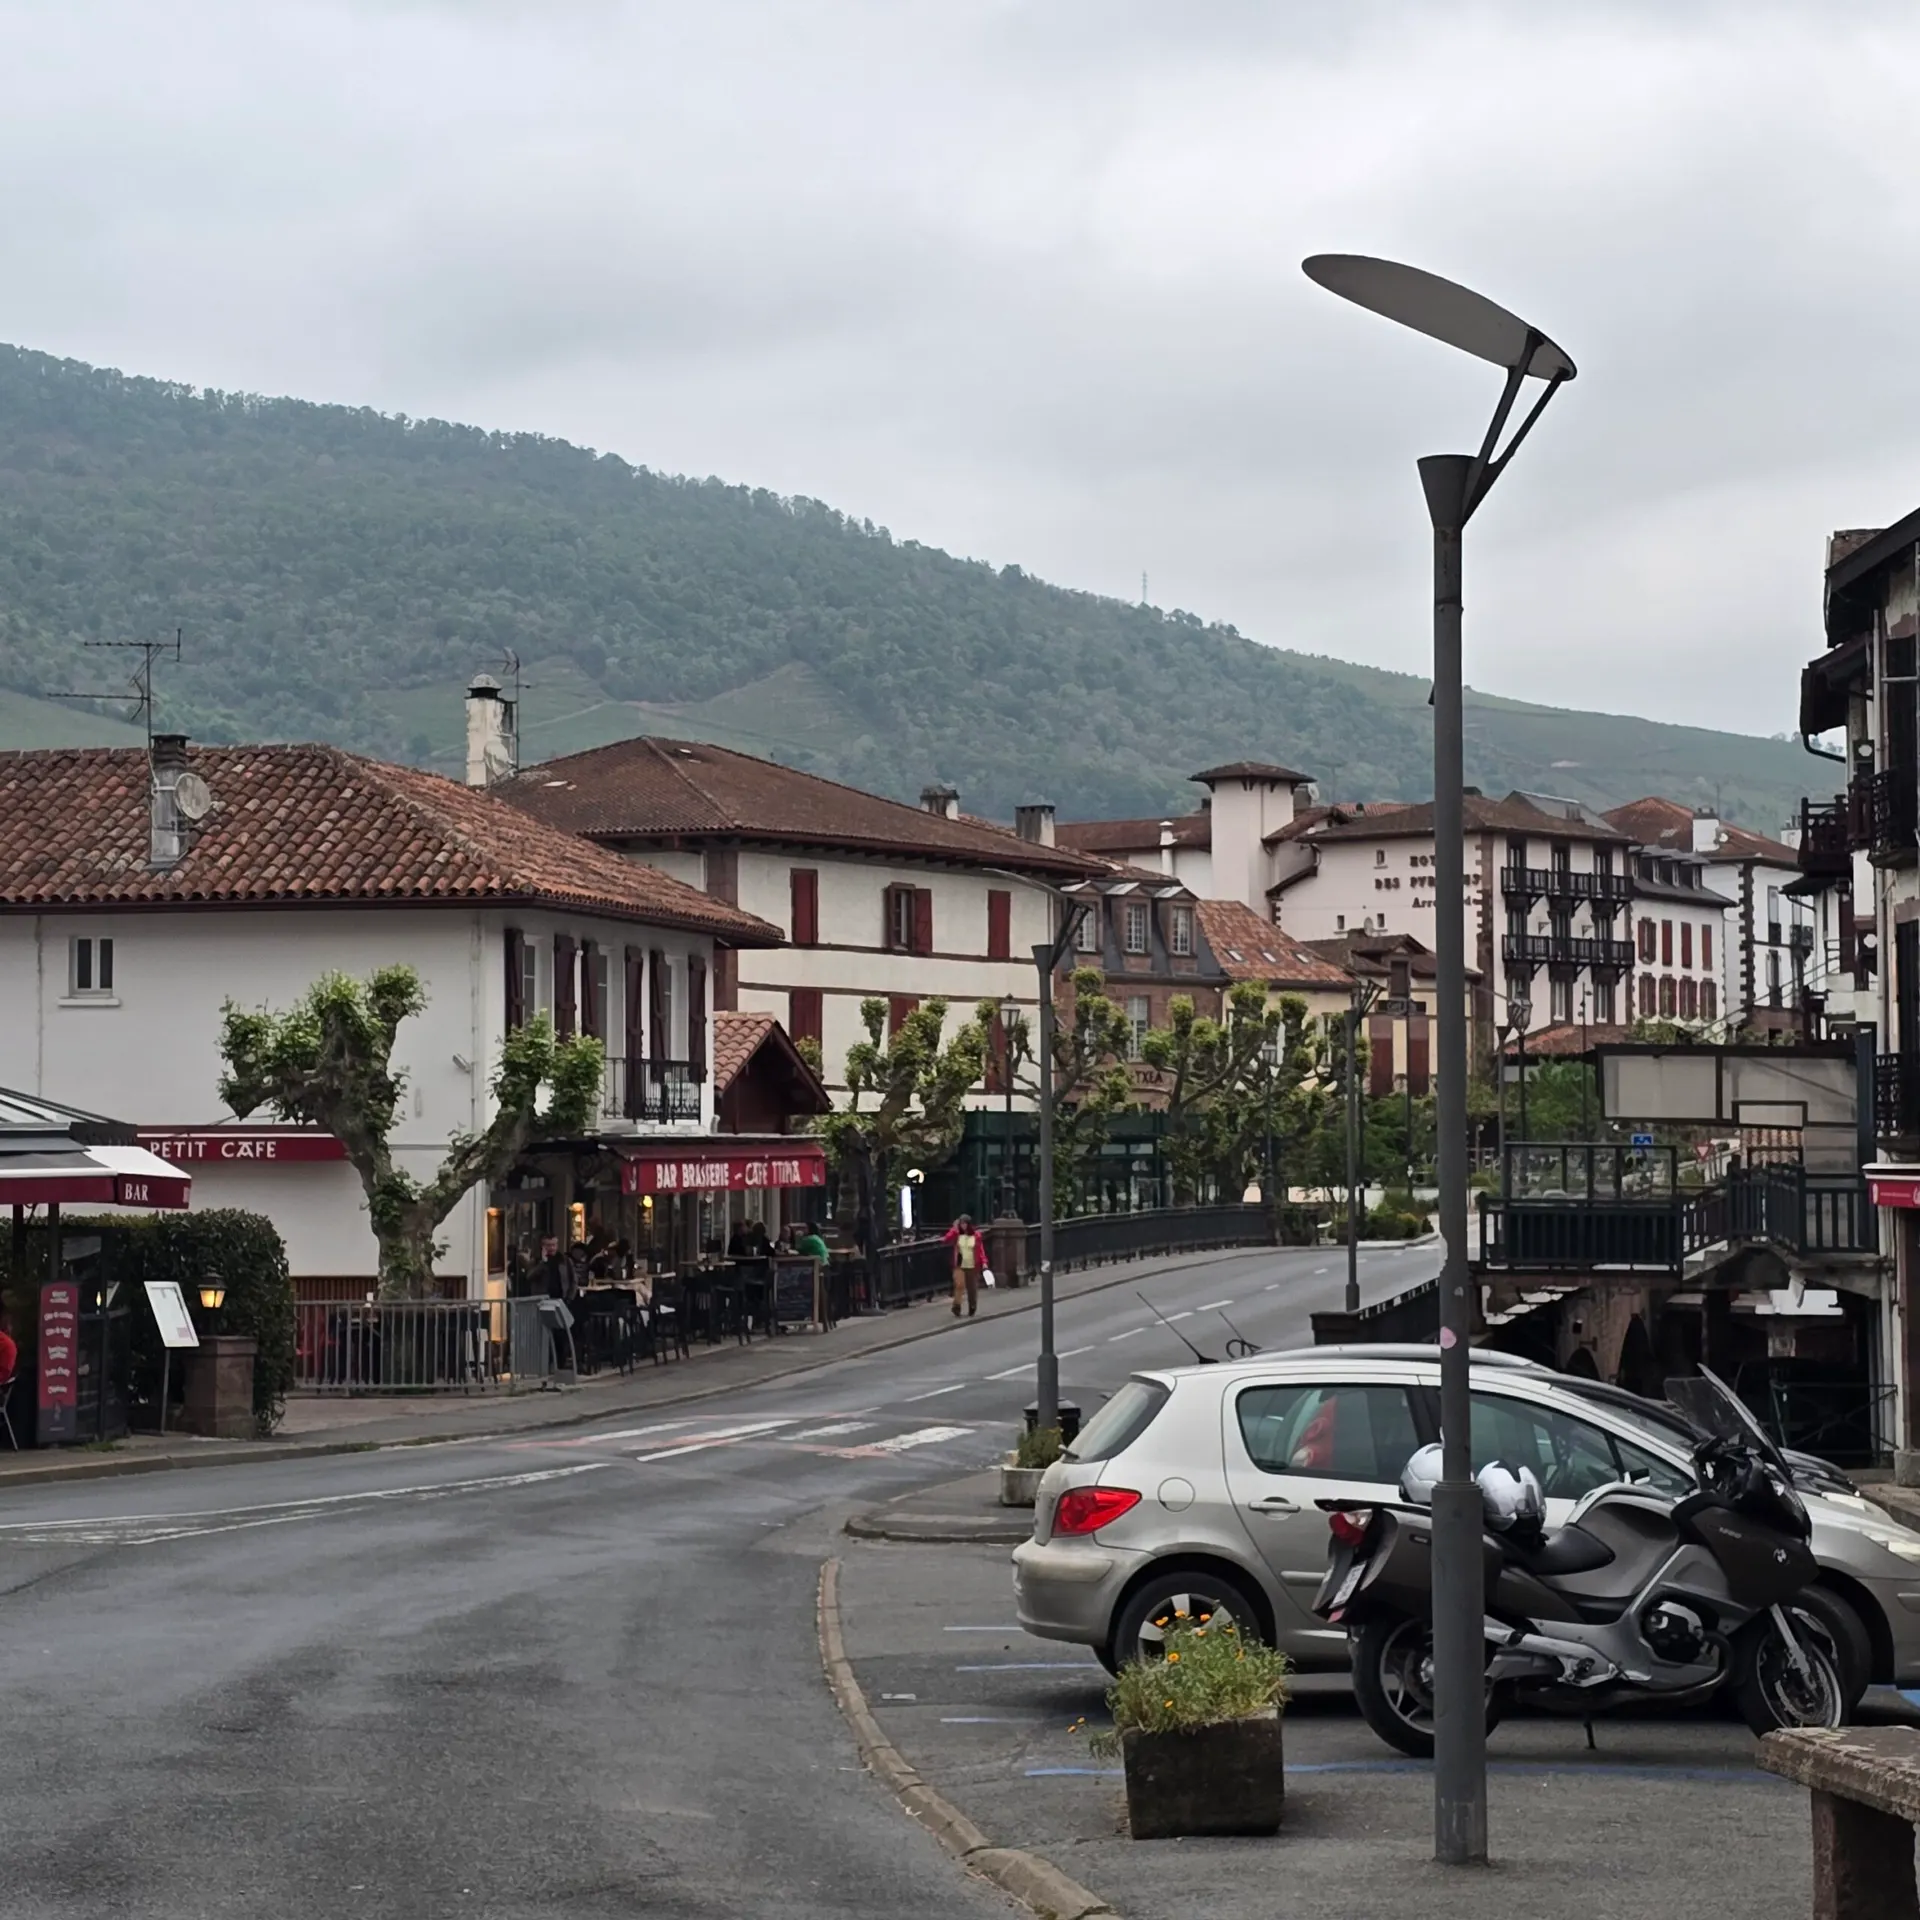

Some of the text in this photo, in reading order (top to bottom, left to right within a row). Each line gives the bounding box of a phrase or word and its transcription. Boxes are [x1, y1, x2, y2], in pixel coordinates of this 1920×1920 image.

[1409, 854, 1436, 868] HOT
[1374, 876, 1400, 890] DES
[150, 1140, 277, 1159] PETIT CAFE
[656, 1163, 677, 1189] BAR
[682, 1162, 730, 1188] BRASSERIE
[124, 1182, 149, 1202] BAR
